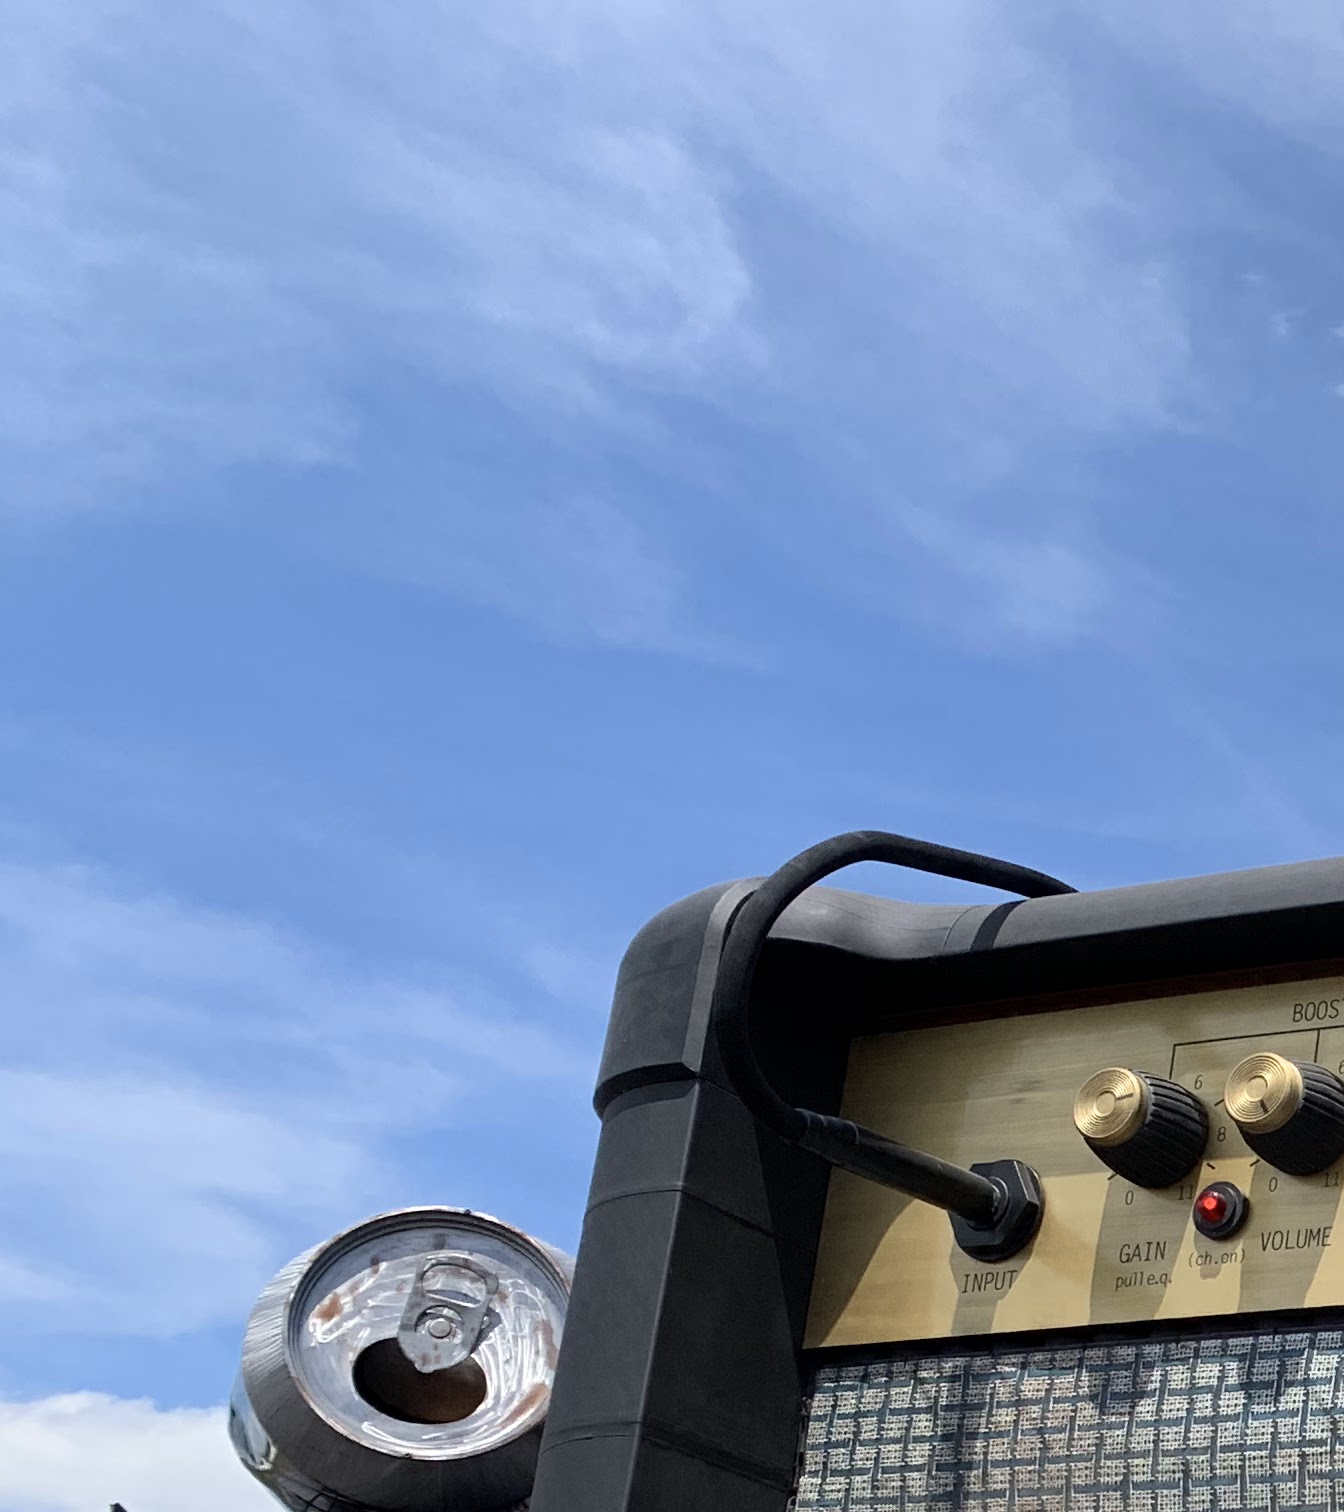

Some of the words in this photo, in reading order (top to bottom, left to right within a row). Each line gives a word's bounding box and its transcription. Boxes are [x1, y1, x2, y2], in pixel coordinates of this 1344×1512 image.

[1193, 1074, 1203, 1091] 6
[1216, 1126, 1227, 1143] 8
[1322, 1171, 1341, 1189] 11
[1260, 1226, 1333, 1253] VOLUME
[1119, 1240, 1167, 1265] GAIN
[962, 1269, 1018, 1294] INPUT
